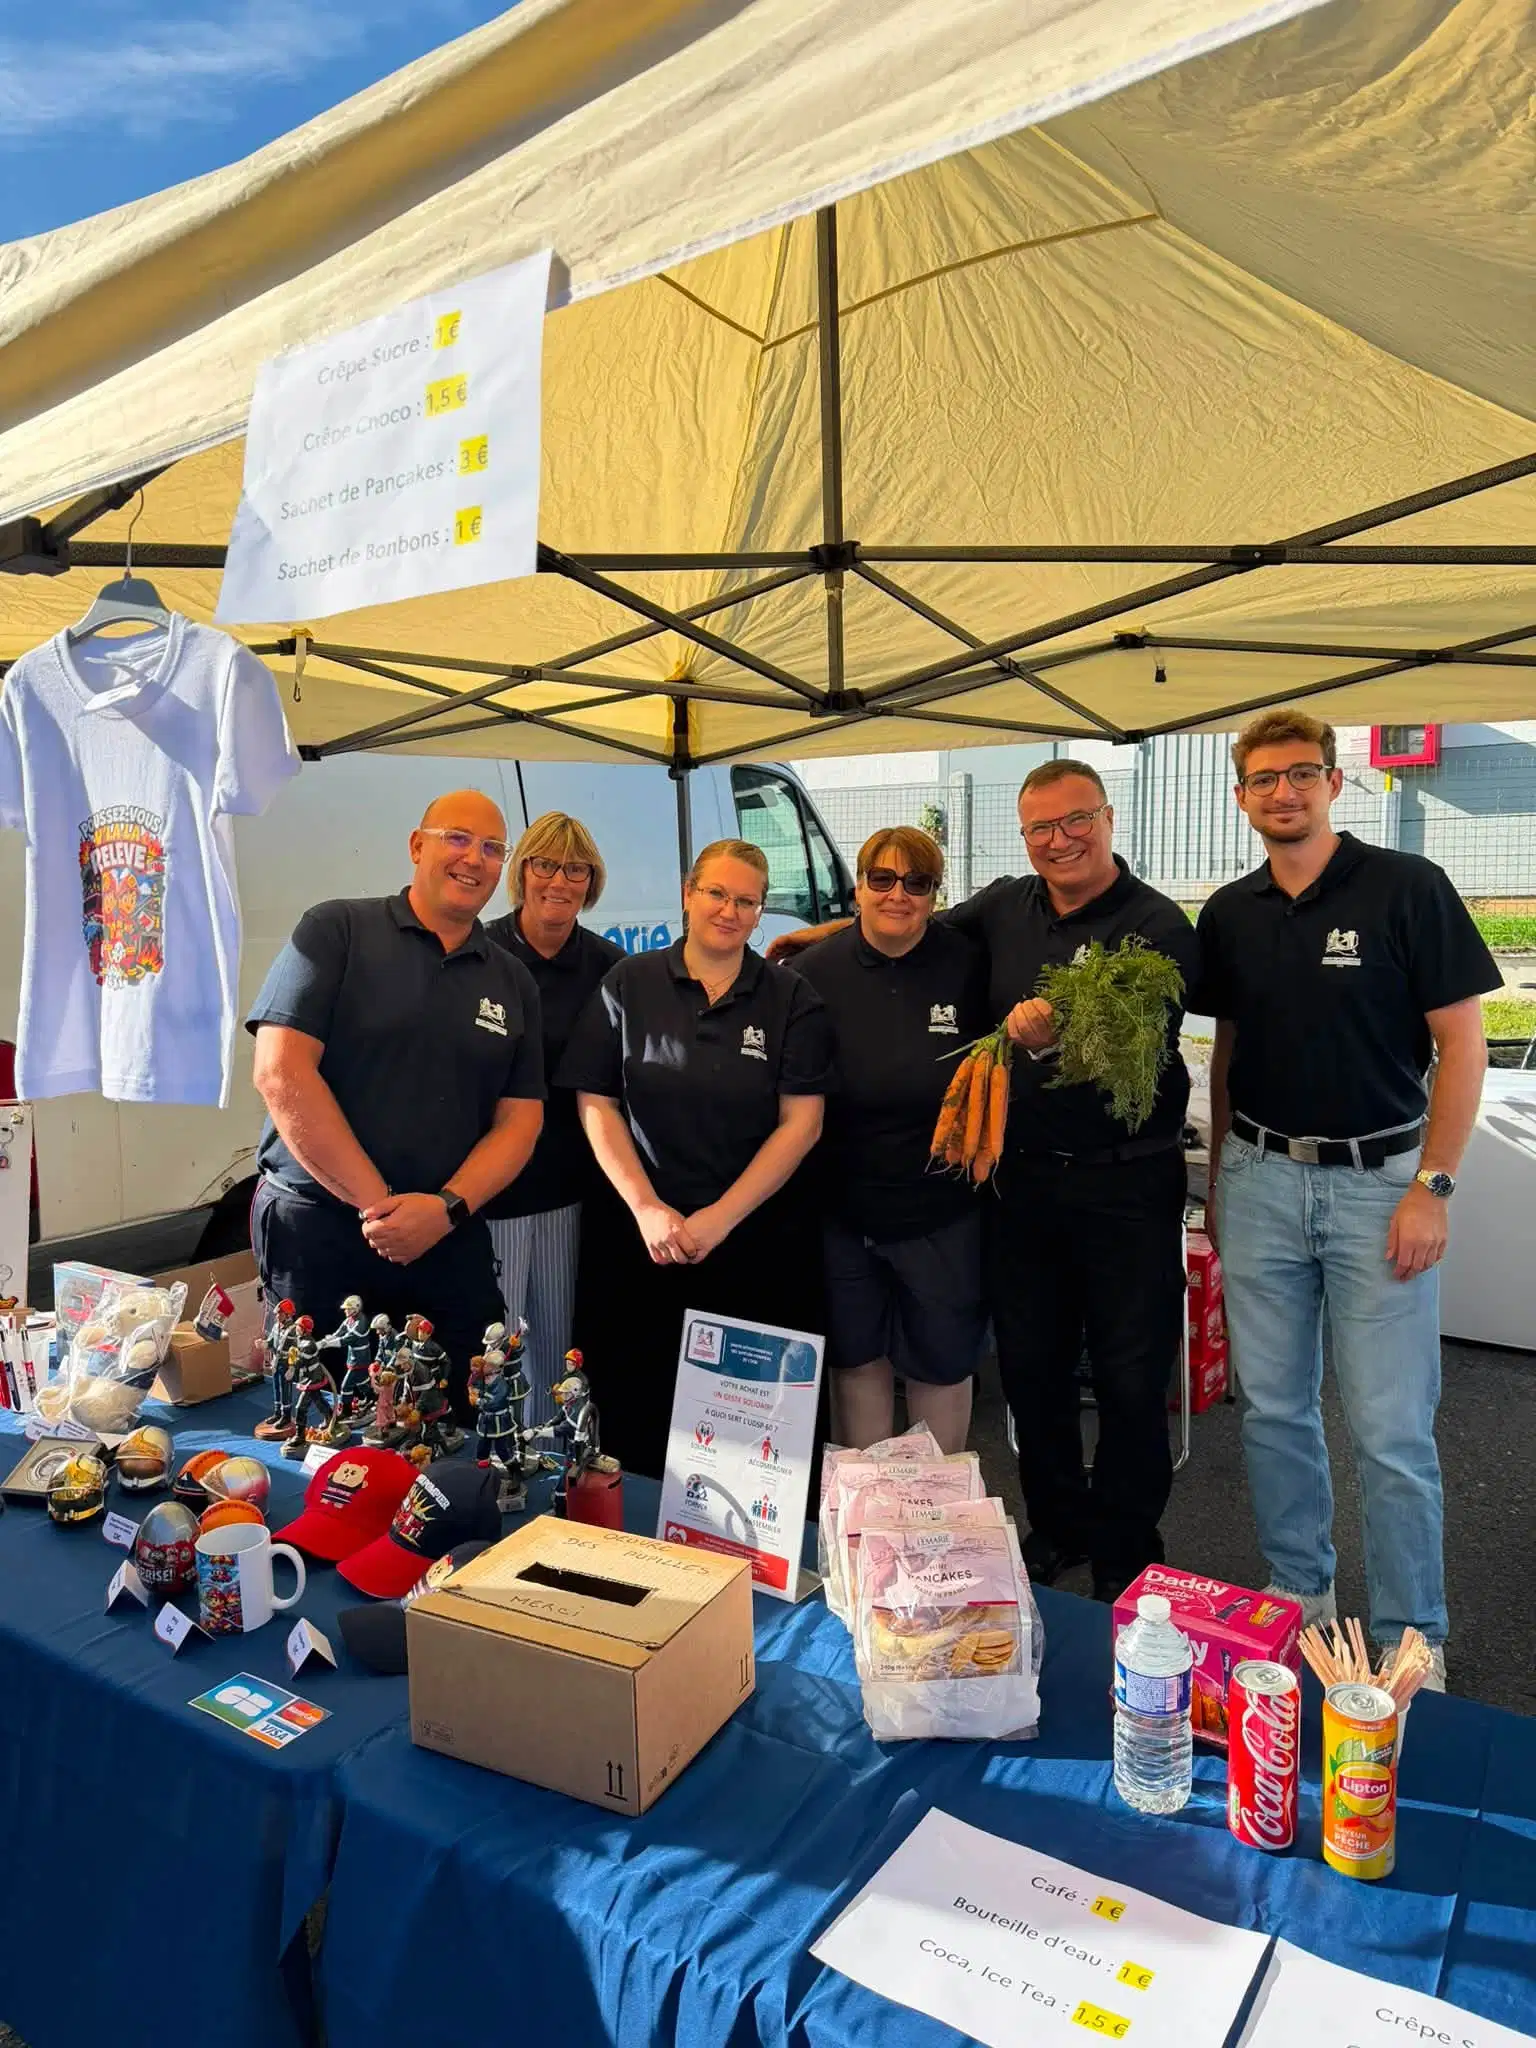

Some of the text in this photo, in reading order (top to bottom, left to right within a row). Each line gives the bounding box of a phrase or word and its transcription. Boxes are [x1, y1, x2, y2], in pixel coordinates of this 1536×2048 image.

[317, 357, 367, 385] Crêpe
[371, 337, 421, 367] Sucre
[303, 426, 351, 452] Crêpe
[356, 404, 412, 434] Choco
[425, 387, 451, 413] 1,5
[280, 491, 335, 520] Sachet
[338, 483, 361, 505] de
[365, 460, 445, 498] Pancakes
[277, 555, 336, 581] Sachet
[338, 547, 361, 570] de
[365, 528, 440, 562] Bonbons
[740, 1383, 760, 1396] ACHAT
[760, 1389, 770, 1398] EST
[711, 1409, 728, 1420] QUOI
[728, 1413, 743, 1423] SERT
[562, 1537, 599, 1550] DES
[1144, 1570, 1230, 1597] Daddy
[260, 1723, 289, 1740] VISA
[1342, 1777, 1388, 1795] Lipton
[1031, 1876, 1077, 1902] Café
[1109, 1906, 1125, 1920] €
[953, 1896, 1040, 1941] Bouteille
[1043, 1936, 1103, 1967] d'eau
[1137, 1974, 1153, 1988] €
[919, 1938, 973, 1974] Coca,
[980, 1965, 1013, 1990] Ice
[1019, 1980, 1057, 2008] Tea
[1076, 2007, 1108, 2030] 1,5
[1113, 2022, 1130, 2038] €
[1375, 2007, 1451, 2046] Crêpe
